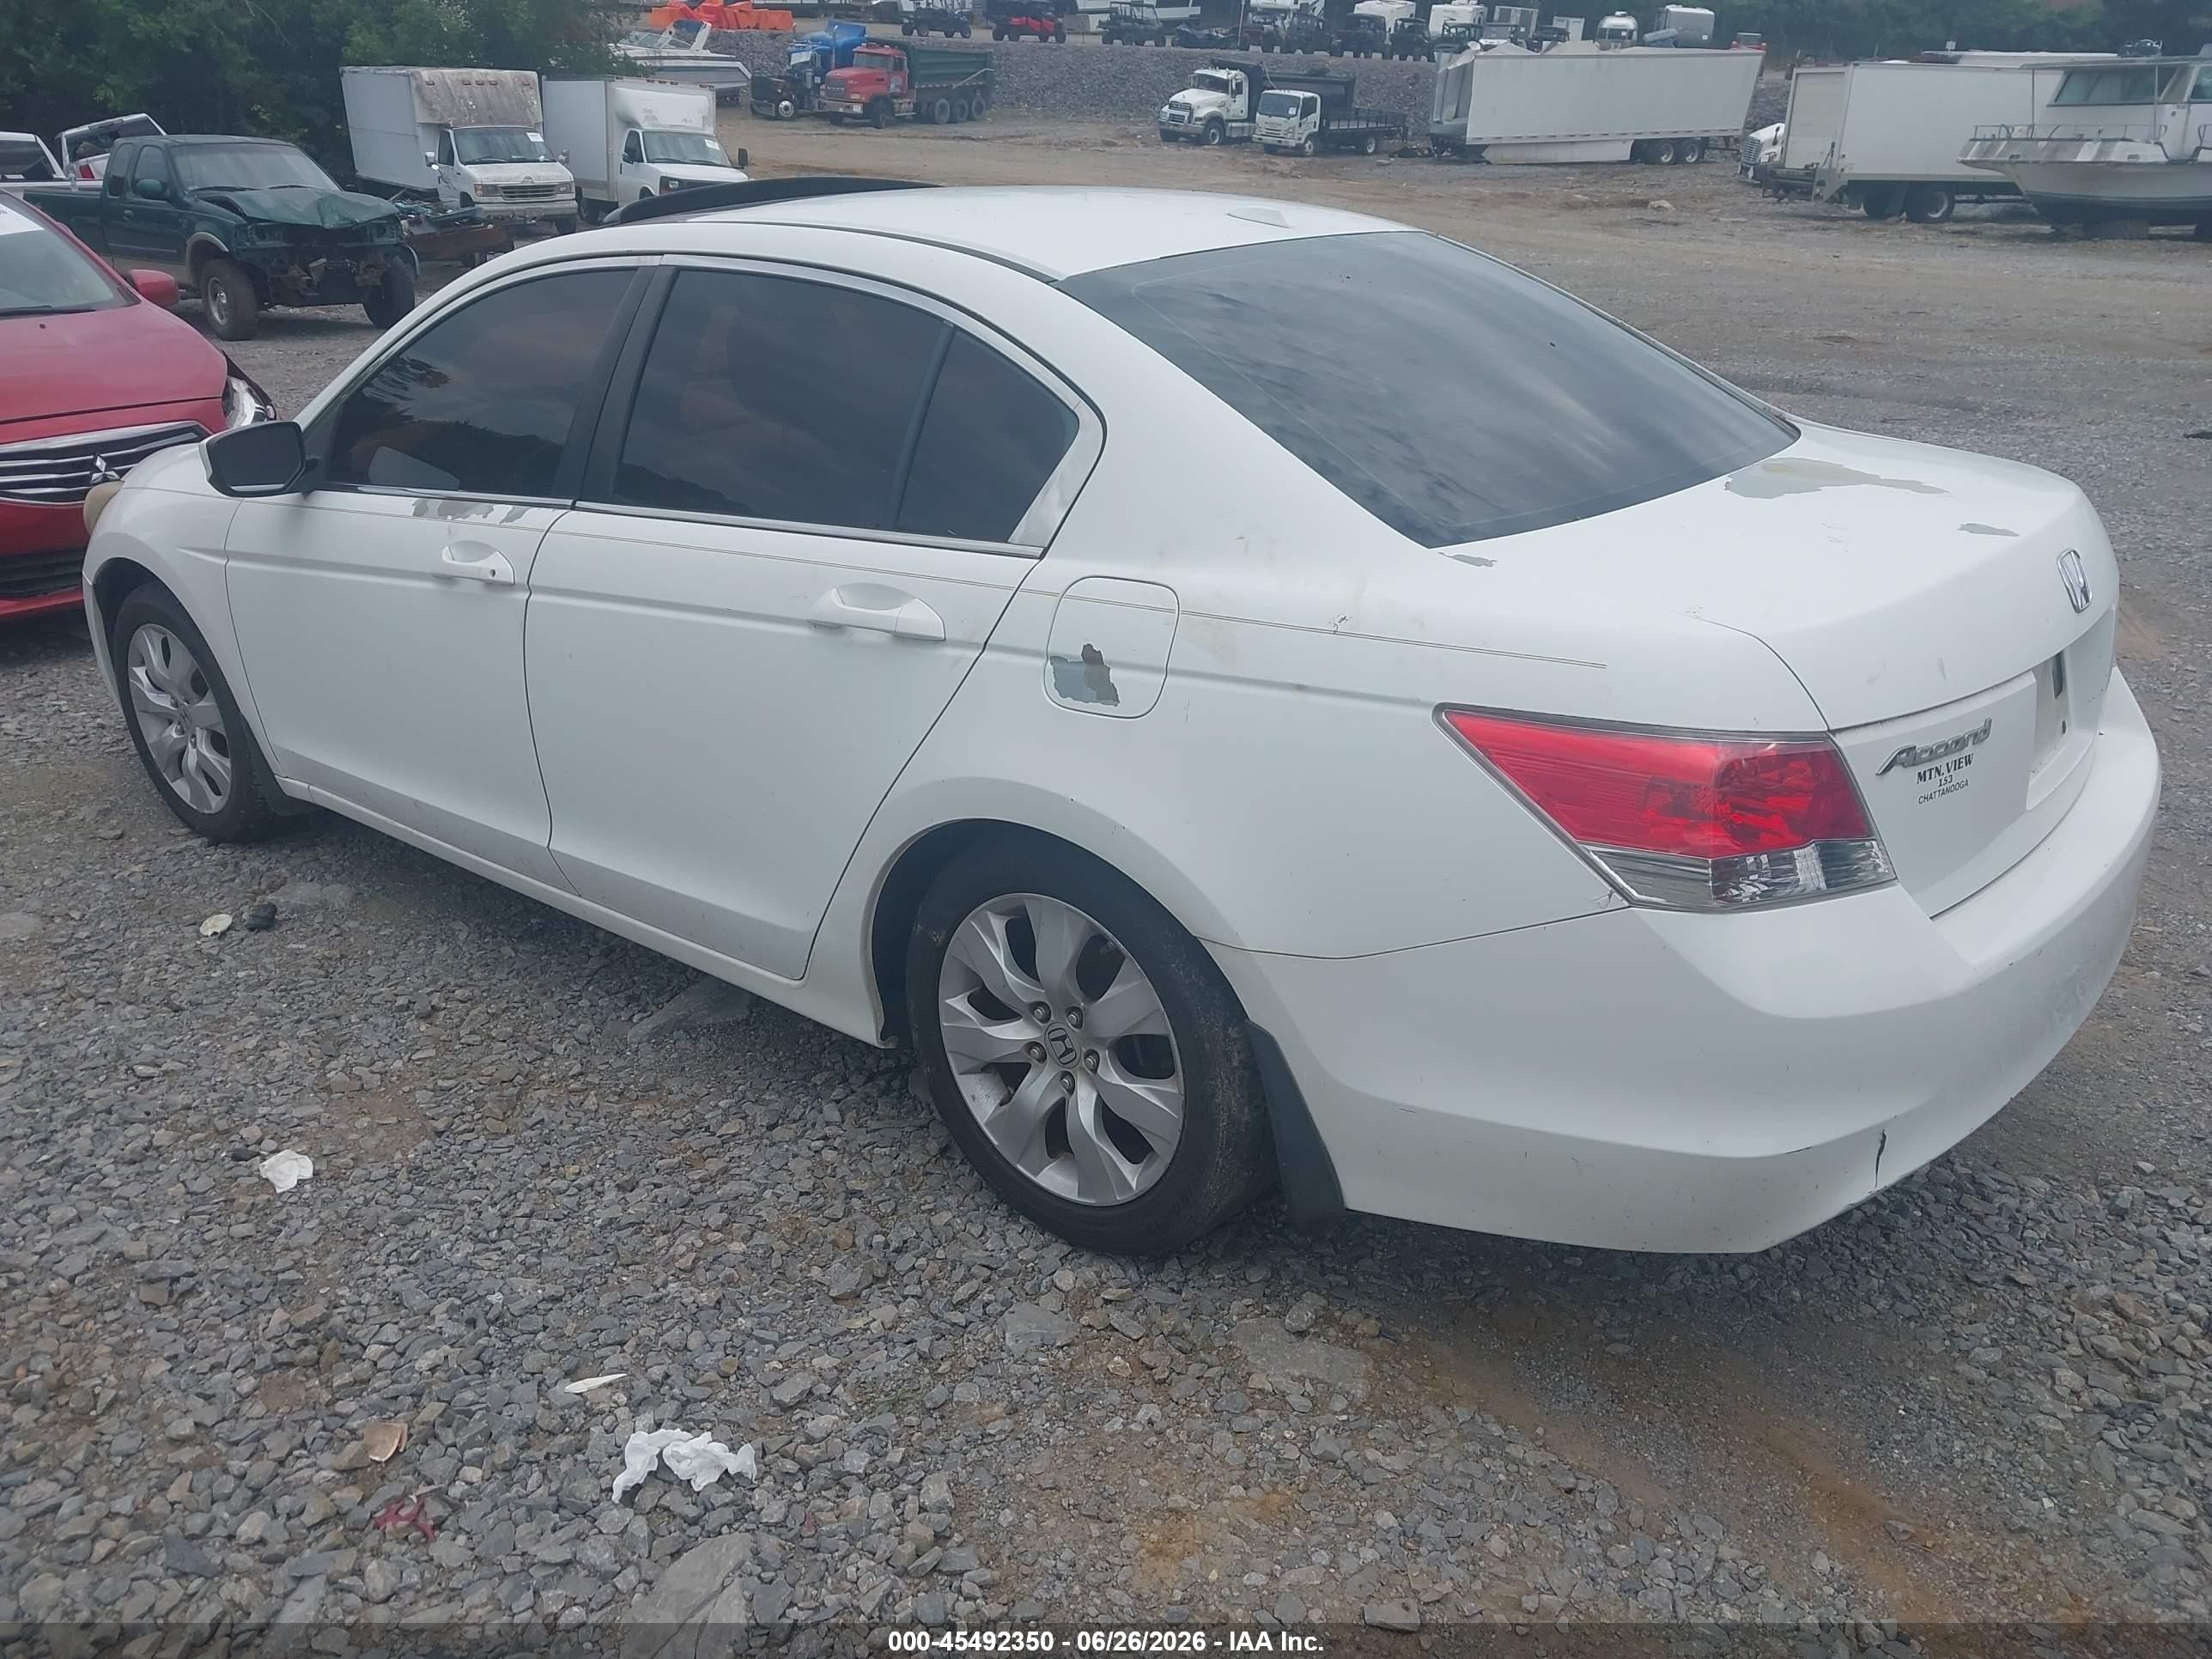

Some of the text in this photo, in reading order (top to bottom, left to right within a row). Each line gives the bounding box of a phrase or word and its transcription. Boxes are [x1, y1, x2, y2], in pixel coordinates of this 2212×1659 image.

[1875, 717, 1993, 775] Accord
[1917, 753, 1974, 785] MTN. VIEW
[1938, 775, 1954, 788] 153
[1917, 779, 1970, 805] CHATTANOOGA
